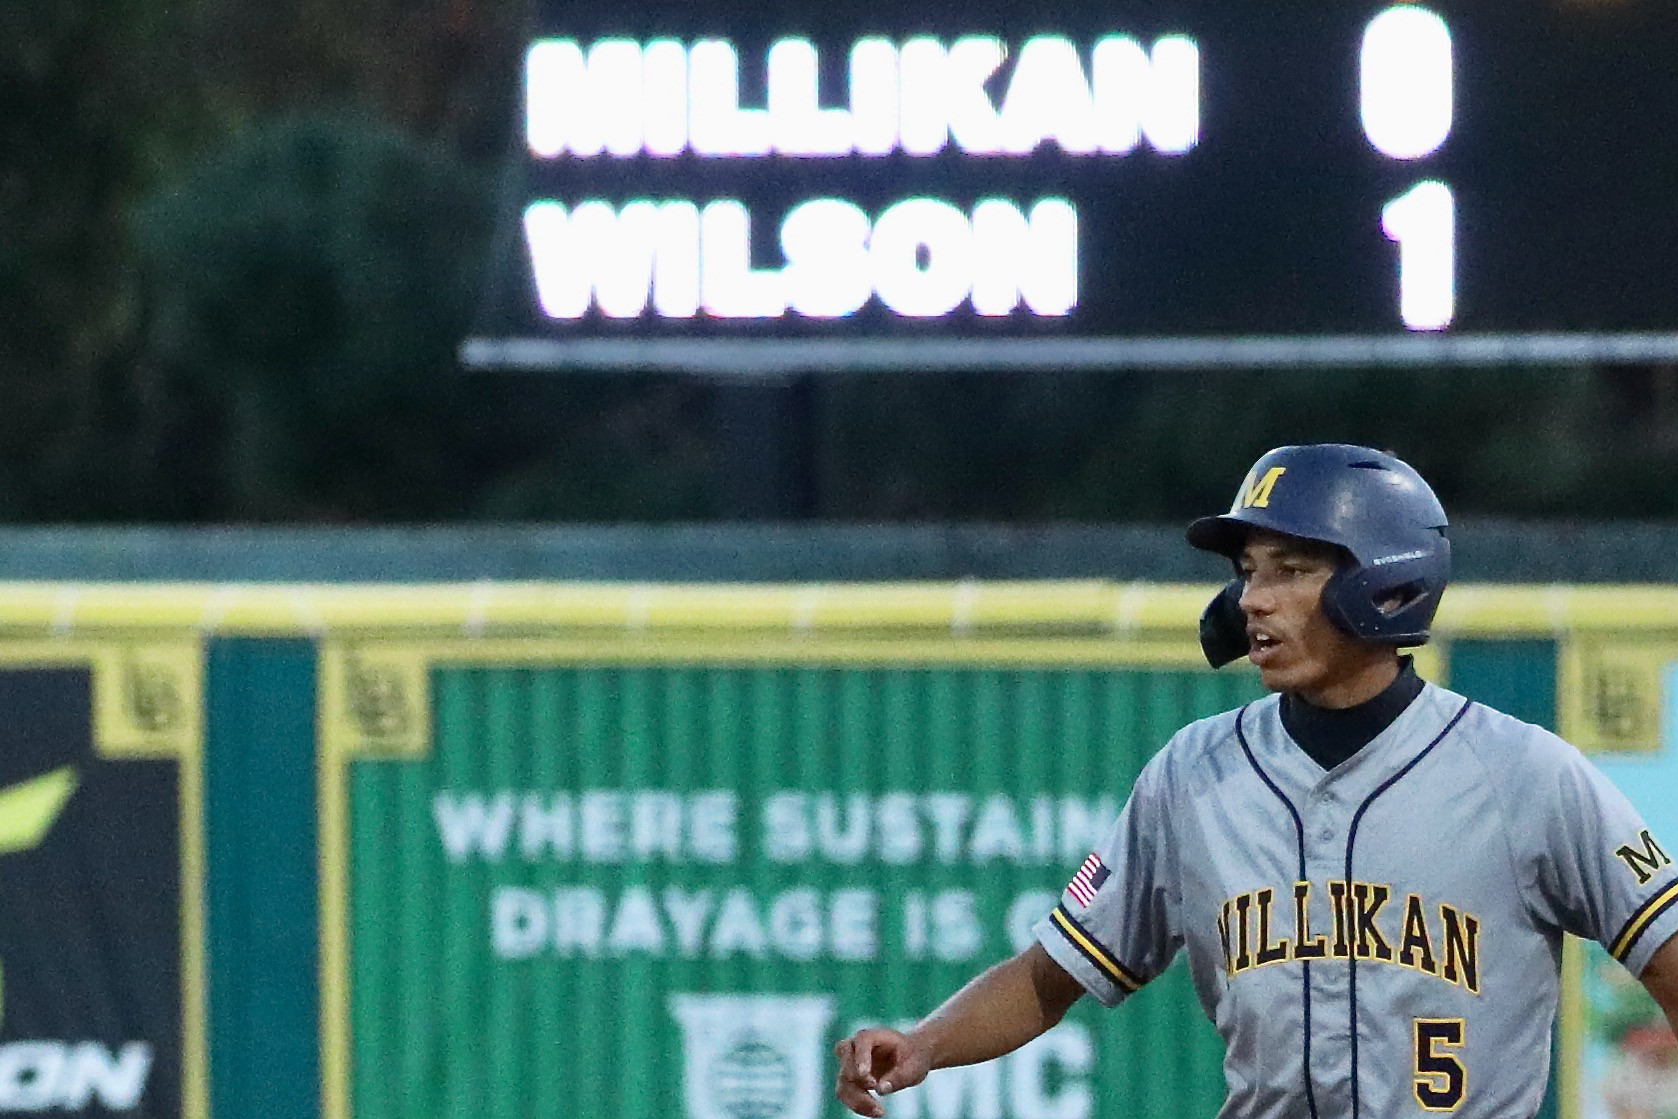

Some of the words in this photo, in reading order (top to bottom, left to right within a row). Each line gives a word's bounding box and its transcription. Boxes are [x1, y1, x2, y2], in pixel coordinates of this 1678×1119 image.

[524, 36, 1200, 158] MILLIKAN
[523, 198, 1079, 319] WILSON
[1381, 180, 1455, 331] 1
[434, 789, 738, 864] WHERE
[1614, 829, 1671, 886] M
[490, 886, 880, 961] DRAYAGE
[903, 888, 984, 960] IS
[1412, 1018, 1466, 1113] 5
